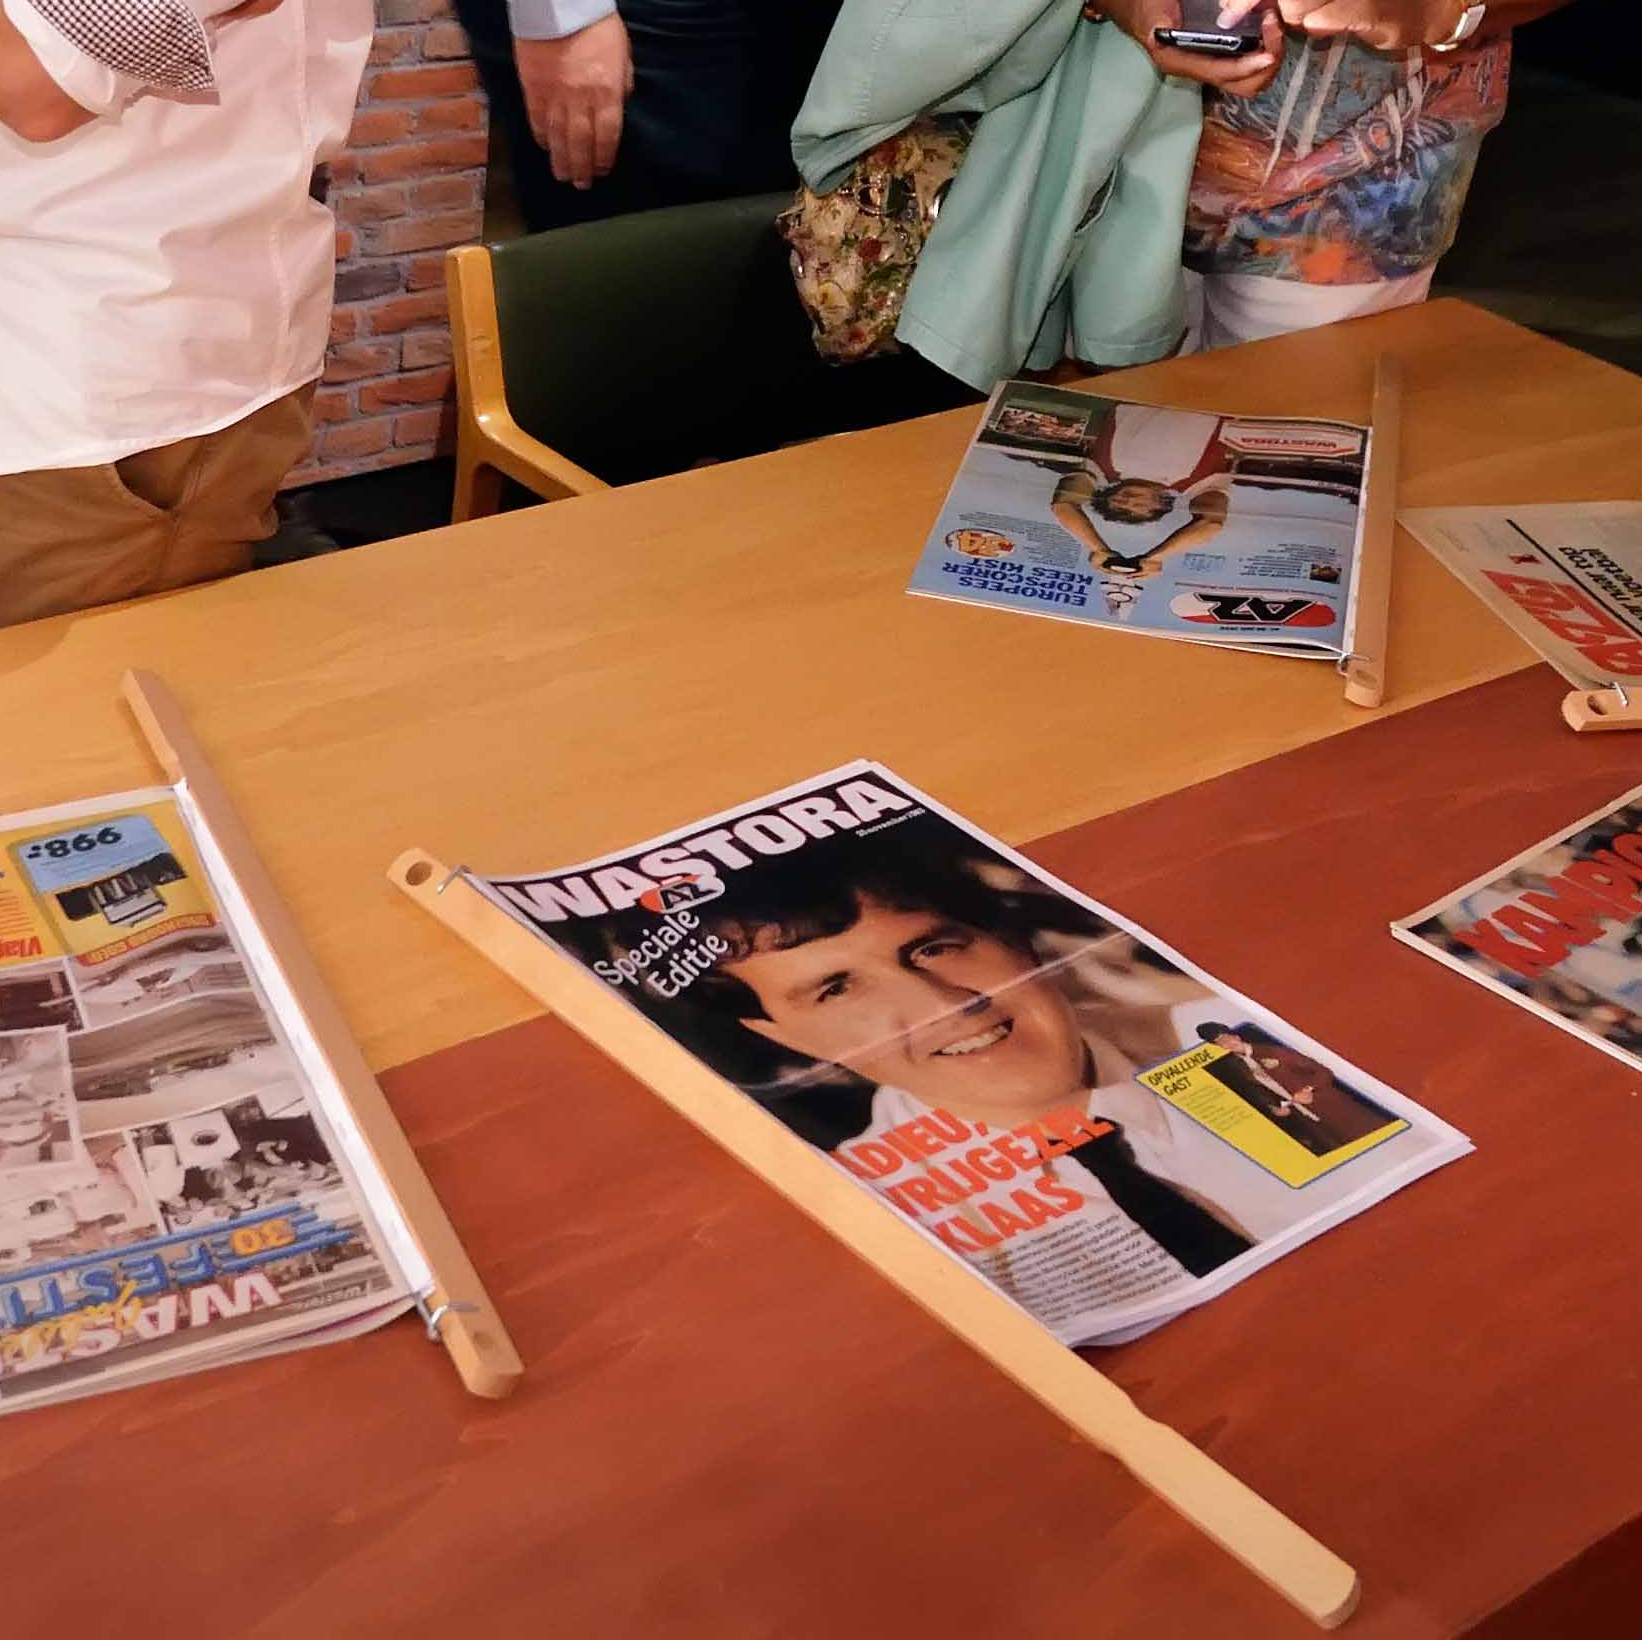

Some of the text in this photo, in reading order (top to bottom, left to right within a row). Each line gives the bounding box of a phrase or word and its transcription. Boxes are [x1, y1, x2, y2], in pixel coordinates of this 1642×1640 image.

[965, 557, 1093, 586] KEES KIST
[1557, 546, 1593, 570] top
[942, 562, 1089, 596] TOPSCORER
[958, 576, 1086, 607] EUROPEES
[1589, 569, 1630, 602] naar
[1193, 592, 1317, 624] AZ
[500, 779, 914, 922] WASTORA
[662, 881, 719, 911] AZ
[593, 910, 701, 986] Speciale
[647, 934, 729, 999] Editie
[1147, 1049, 1215, 1086] OPVALLENDE
[1163, 1076, 1192, 1096] GAST
[934, 1175, 1085, 1254] KLAAS
[230, 1218, 295, 1256] 30
